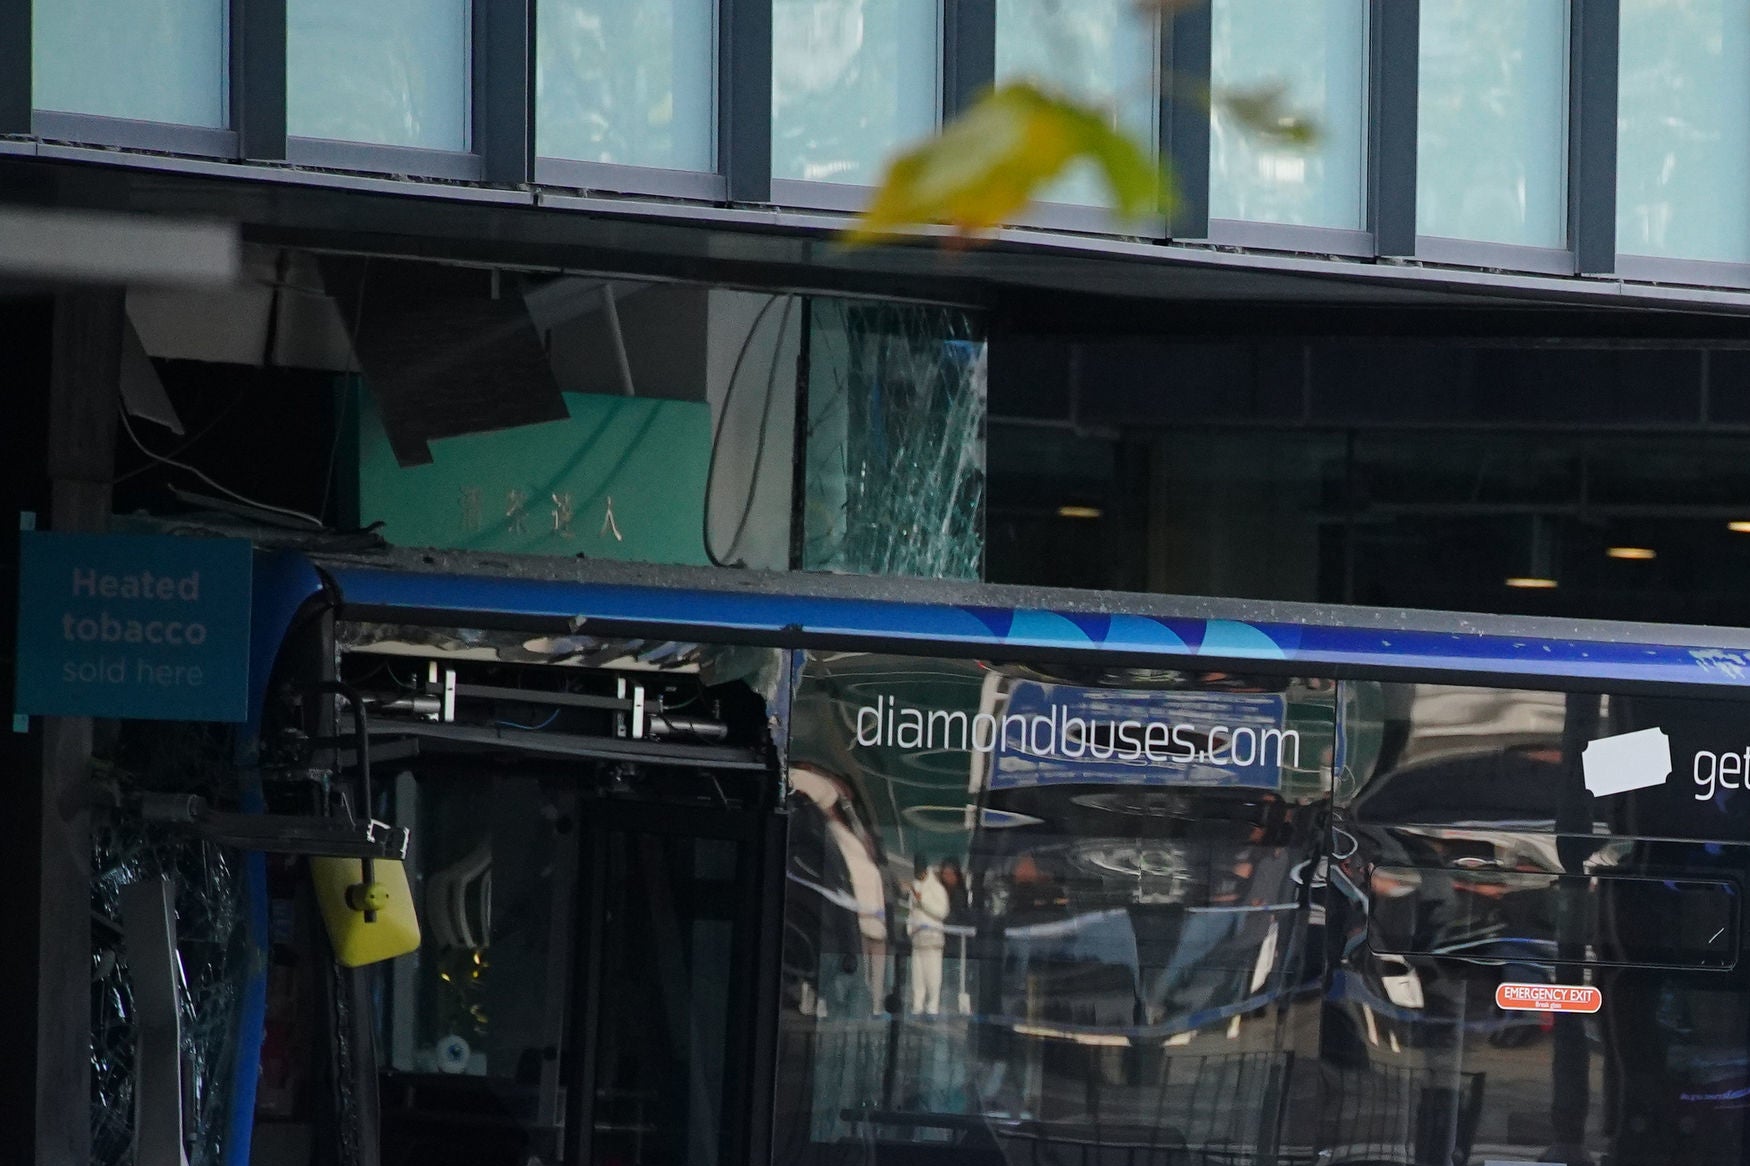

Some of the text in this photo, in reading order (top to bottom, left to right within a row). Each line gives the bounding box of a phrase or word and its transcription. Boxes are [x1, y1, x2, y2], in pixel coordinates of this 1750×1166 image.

[72, 567, 200, 600] Heated
[62, 613, 206, 643] tobacco
[62, 657, 203, 687] sold here
[856, 694, 1301, 769] diamondbuses.com
[1504, 987, 1593, 1002] EMERGENCY EXIT
